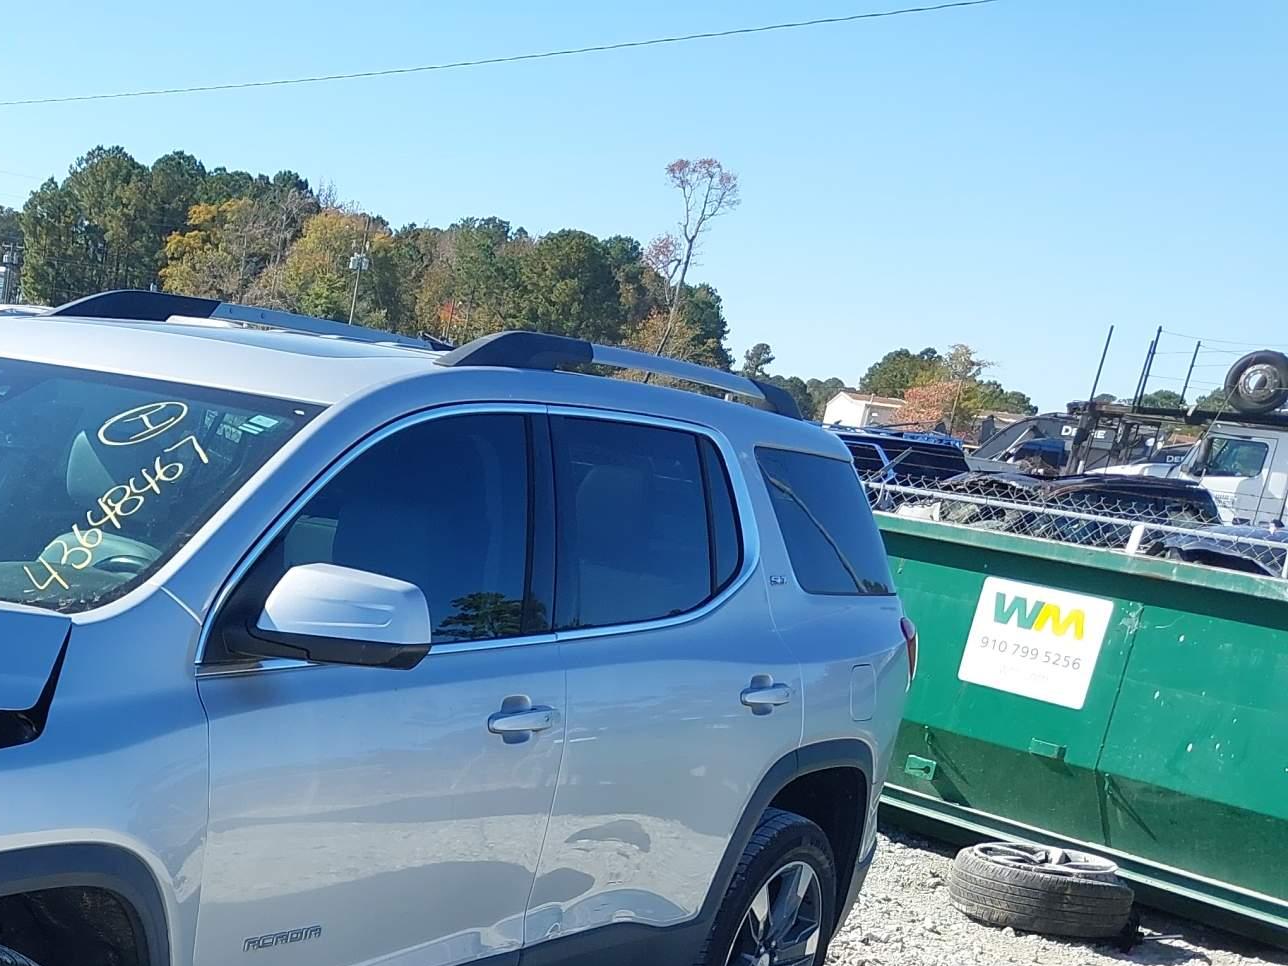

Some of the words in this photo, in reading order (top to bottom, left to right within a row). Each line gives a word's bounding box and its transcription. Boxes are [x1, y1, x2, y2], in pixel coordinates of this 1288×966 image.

[23, 435, 209, 590] 43648467
[993, 591, 1086, 641] WM
[979, 635, 1008, 653] 910
[1012, 643, 1039, 660] 799
[1043, 650, 1082, 671] 5256
[242, 924, 322, 952] ACADIA
